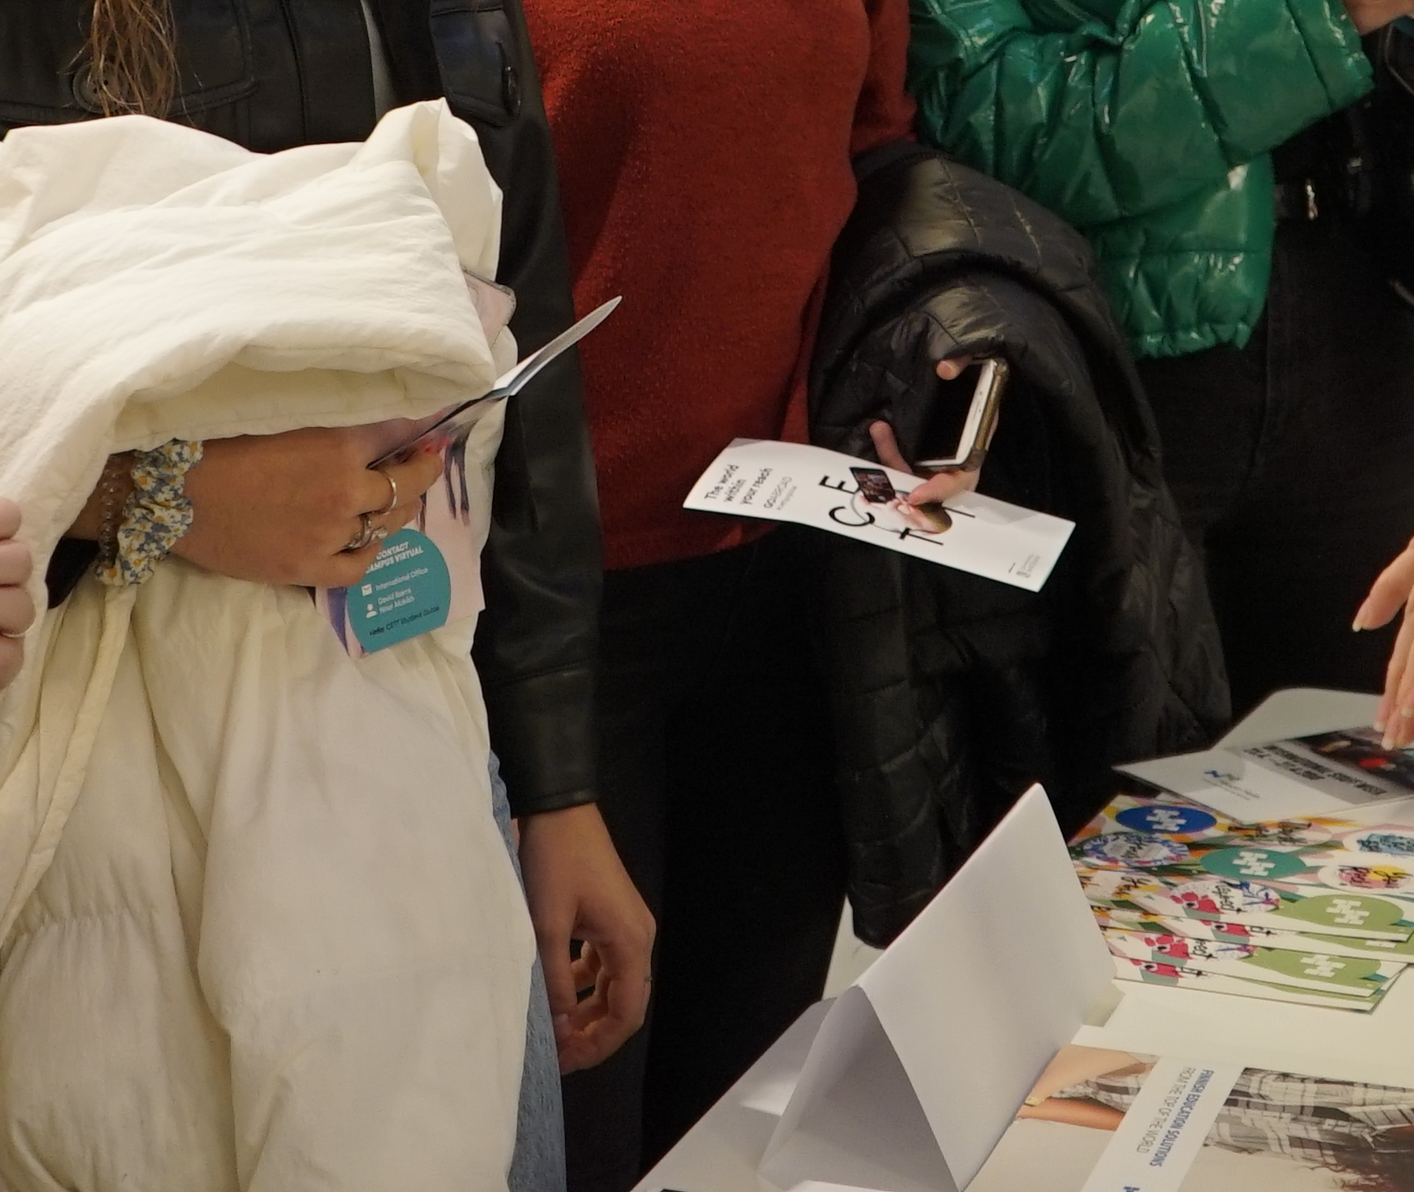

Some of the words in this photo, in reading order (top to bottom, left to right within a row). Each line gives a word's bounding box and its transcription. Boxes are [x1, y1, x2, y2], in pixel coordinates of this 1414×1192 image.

[704, 484, 724, 500] The
[719, 464, 740, 486] world
[724, 478, 747, 502] within
[740, 487, 758, 506] your
[752, 467, 774, 489] reach
[365, 556, 395, 574] AMPUS
[395, 545, 424, 563] VIRTUAL
[376, 541, 409, 560] CONTACT
[376, 573, 410, 591] International
[1177, 1066, 1196, 1083] FROM
[1191, 1069, 1214, 1093] FINNISH
[1169, 1082, 1187, 1095] THE
[1170, 1094, 1200, 1129] EDUCATION
[1137, 1129, 1159, 1153] WORLD
[1149, 1129, 1180, 1167] SOLUTIONS
